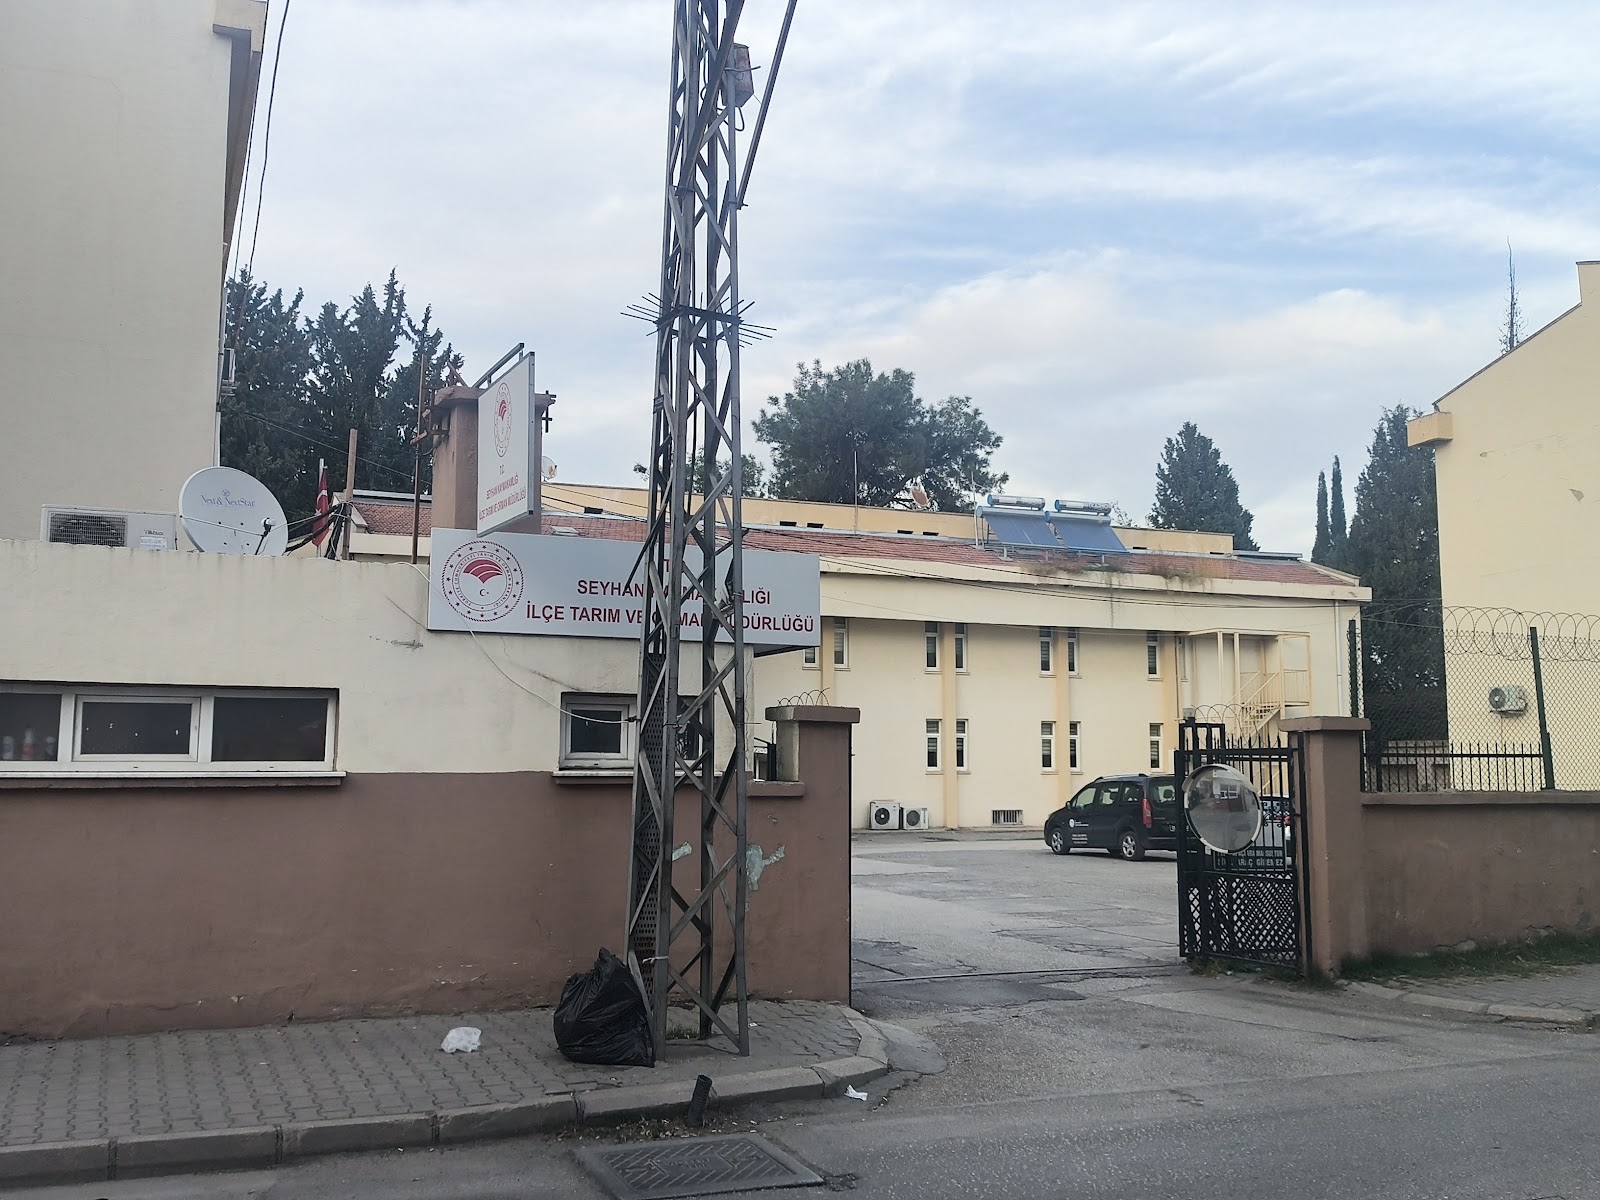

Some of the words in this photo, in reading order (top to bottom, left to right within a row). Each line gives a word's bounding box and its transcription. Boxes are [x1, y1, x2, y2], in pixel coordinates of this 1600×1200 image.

[577, 579, 645, 598] SEYHAN
[526, 600, 565, 623] İLÇE
[569, 606, 621, 623] TARIM
